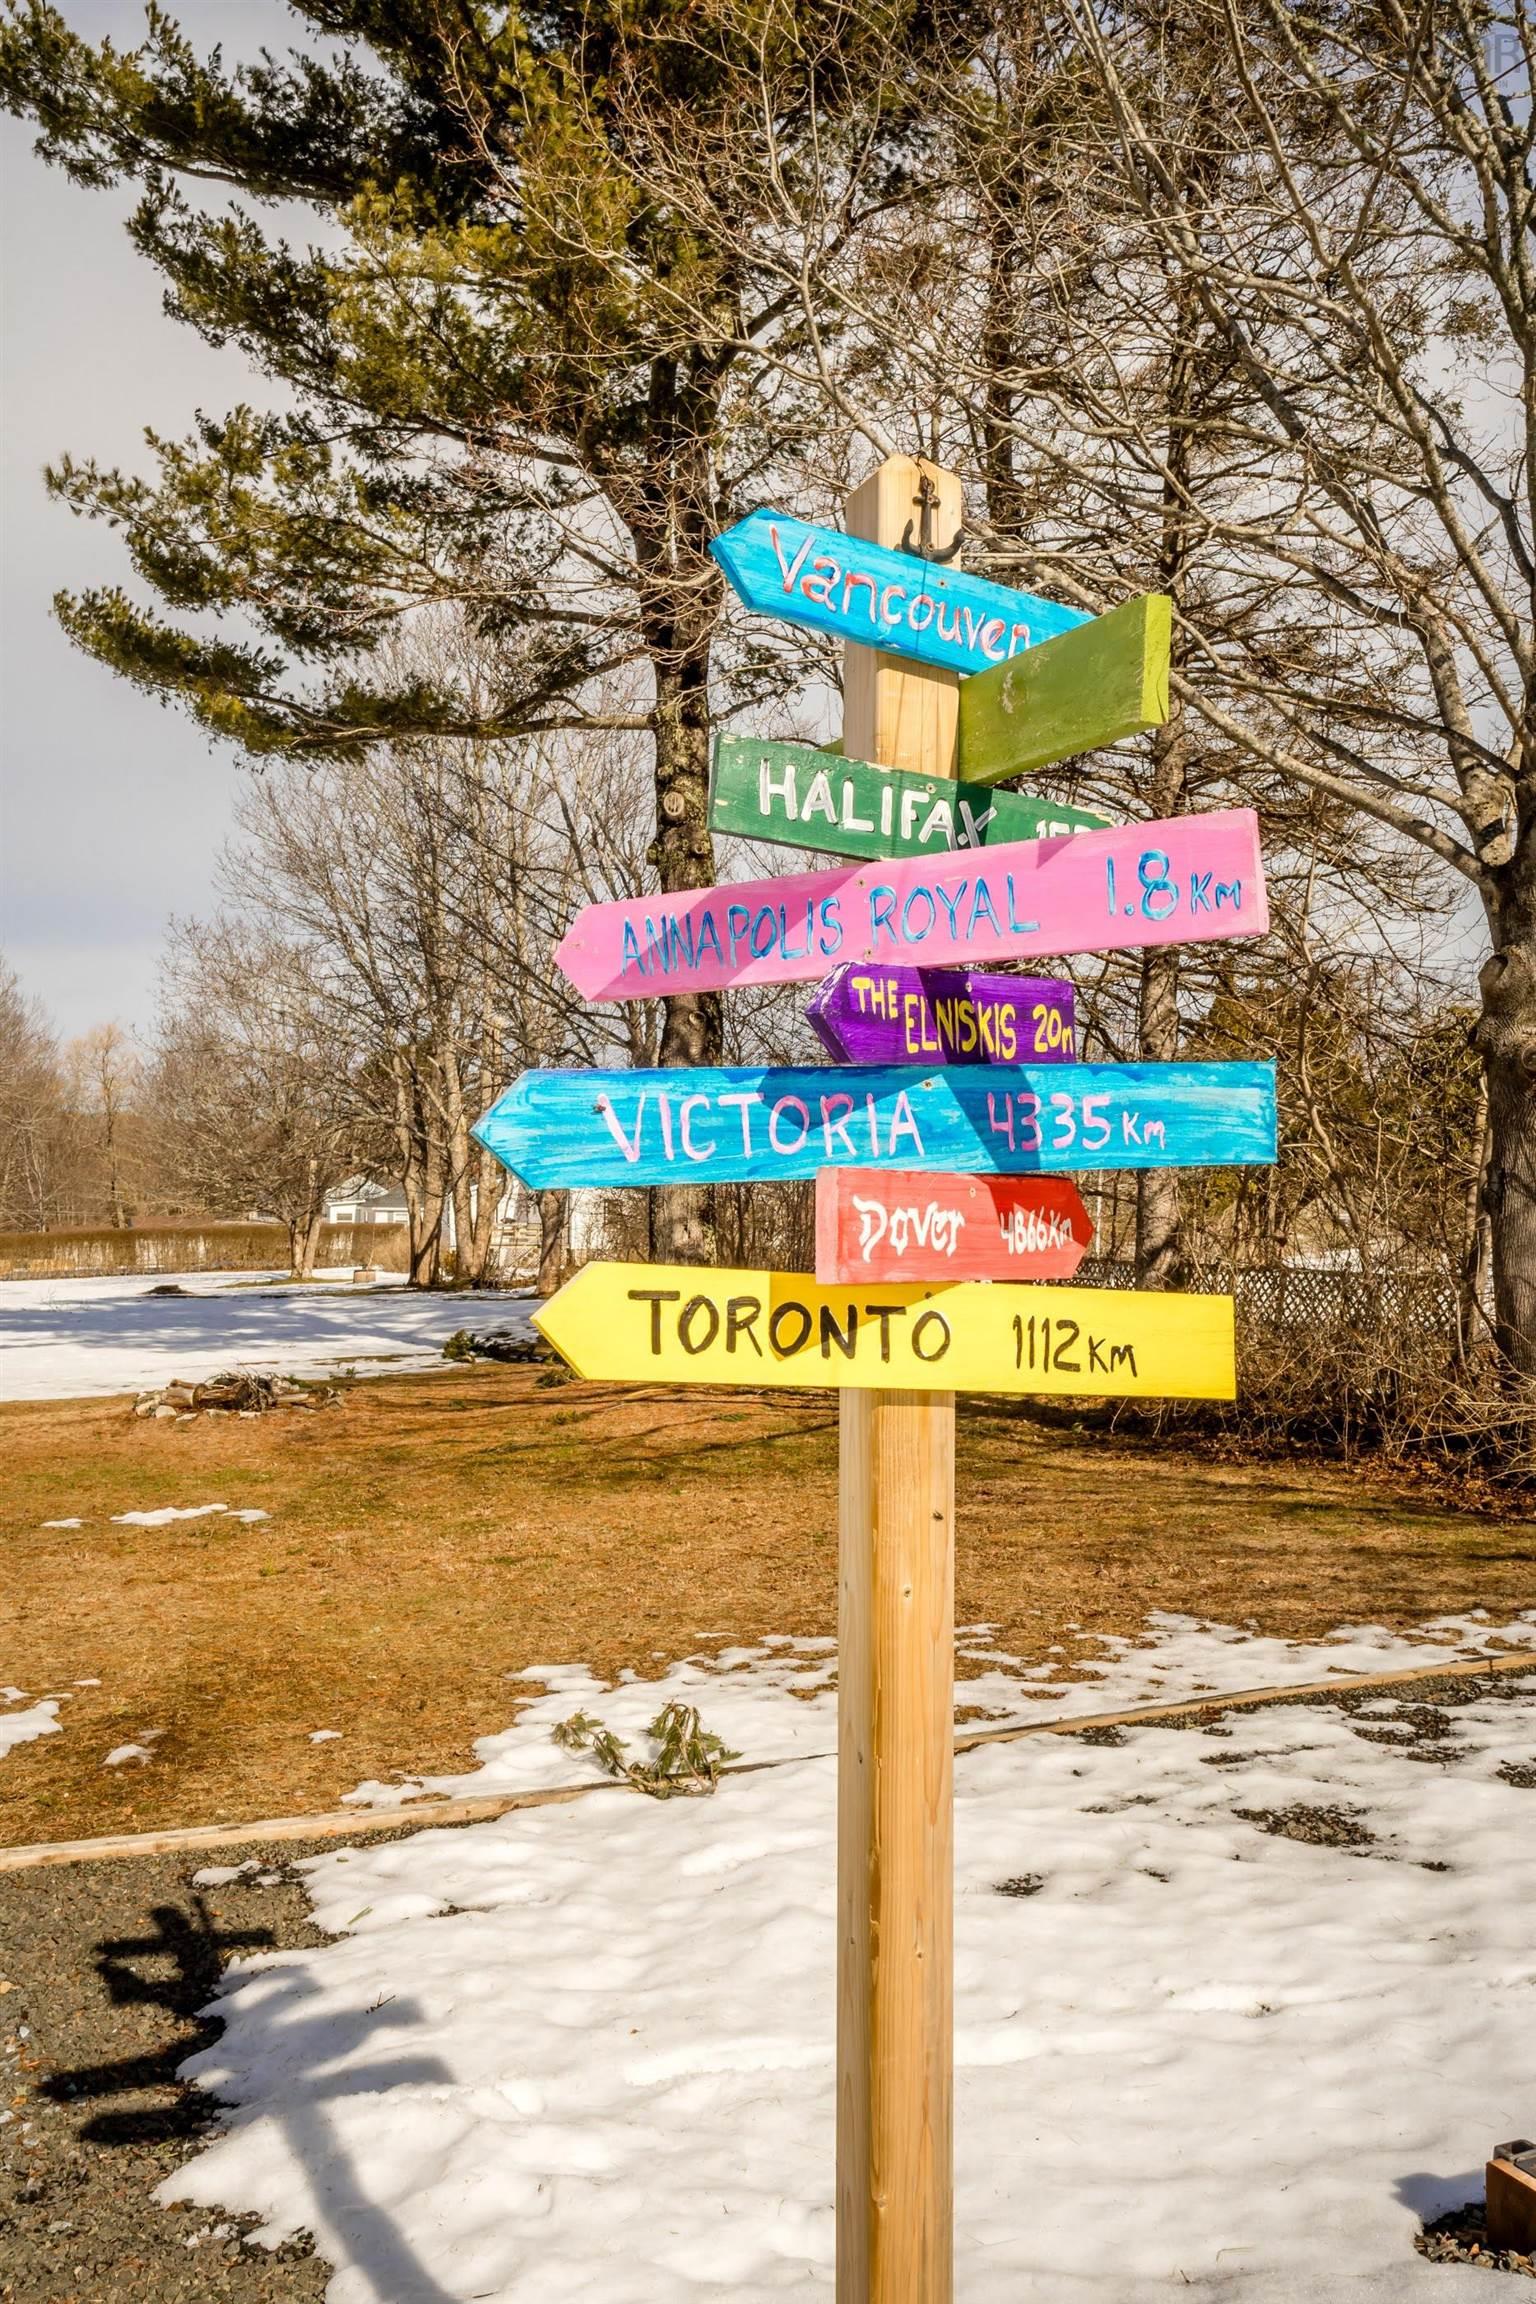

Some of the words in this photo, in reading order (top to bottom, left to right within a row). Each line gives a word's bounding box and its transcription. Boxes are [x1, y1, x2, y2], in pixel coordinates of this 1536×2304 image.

[758, 757, 998, 853] HALIFAX
[620, 895, 844, 977] ANNAPOLIS
[869, 872, 1040, 947] ROYAL
[1105, 848, 1180, 921] 1.8
[851, 976, 899, 1021] THE
[904, 993, 1017, 1060] ELNISKIS
[599, 1091, 925, 1163] VICTORIA
[986, 1092, 1112, 1152] 4335
[852, 1194, 966, 1264] Dover
[628, 1289, 952, 1362] TORONTO
[1012, 1314, 1082, 1373] 1112
